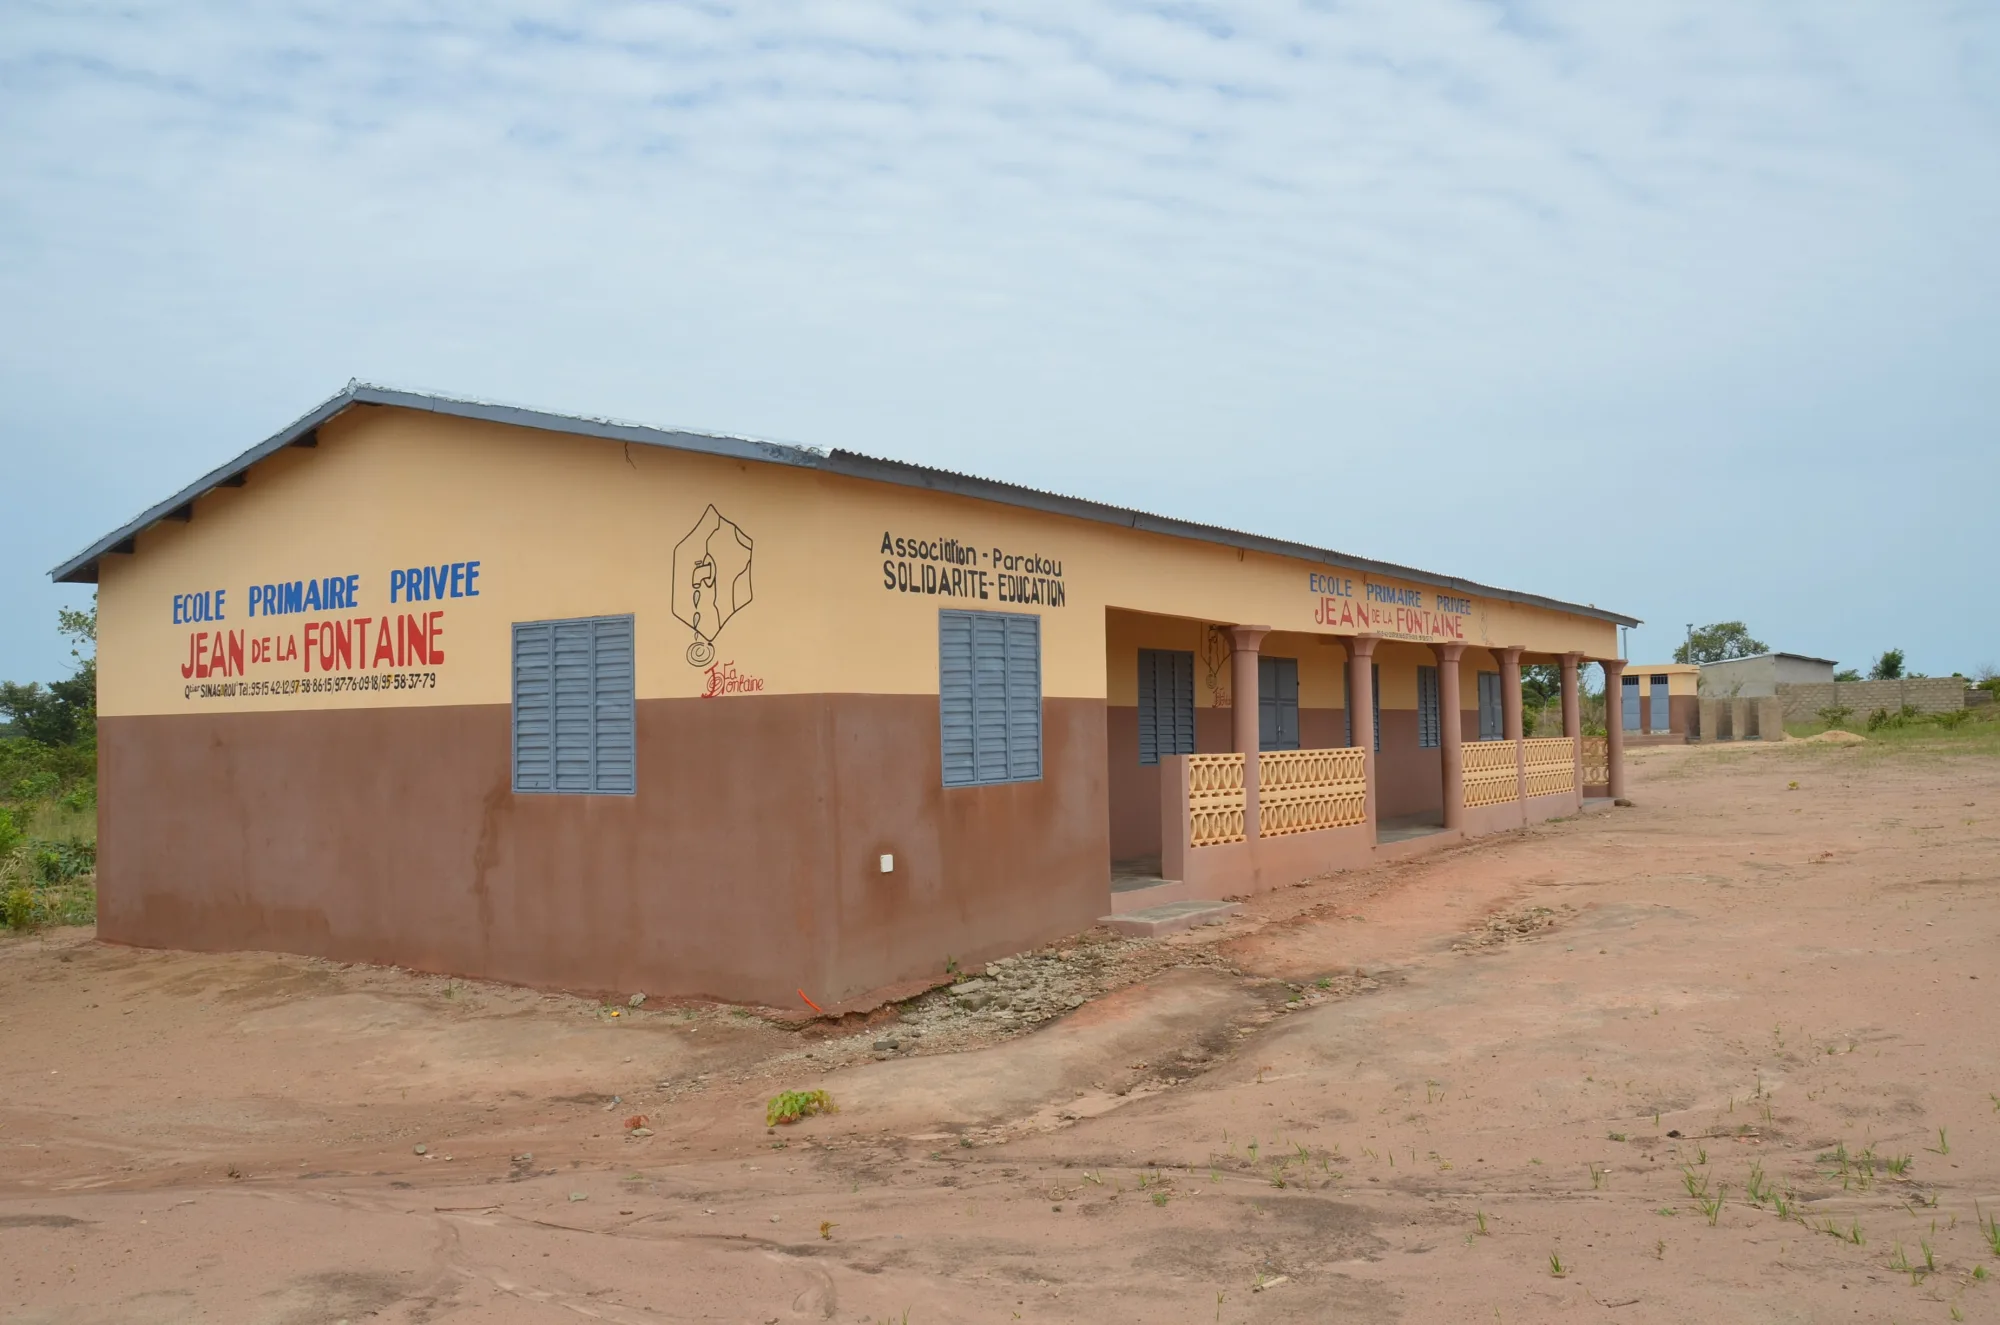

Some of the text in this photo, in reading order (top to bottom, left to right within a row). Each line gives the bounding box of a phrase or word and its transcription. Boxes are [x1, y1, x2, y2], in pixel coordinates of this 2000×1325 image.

[880, 531, 977, 566] Association
[993, 548, 1062, 577] Parakou
[173, 561, 481, 625] ECOLE PRIMAIRE PRIVEE
[1309, 573, 1472, 615] ECOLE PRIMAIRE PRIVEE
[1314, 597, 1370, 629] JEAN
[1371, 608, 1381, 624] DE
[1382, 609, 1393, 625] LA
[1396, 607, 1464, 639] FONTAINE
[181, 610, 445, 679] JEAN DE LA FONTAINE
